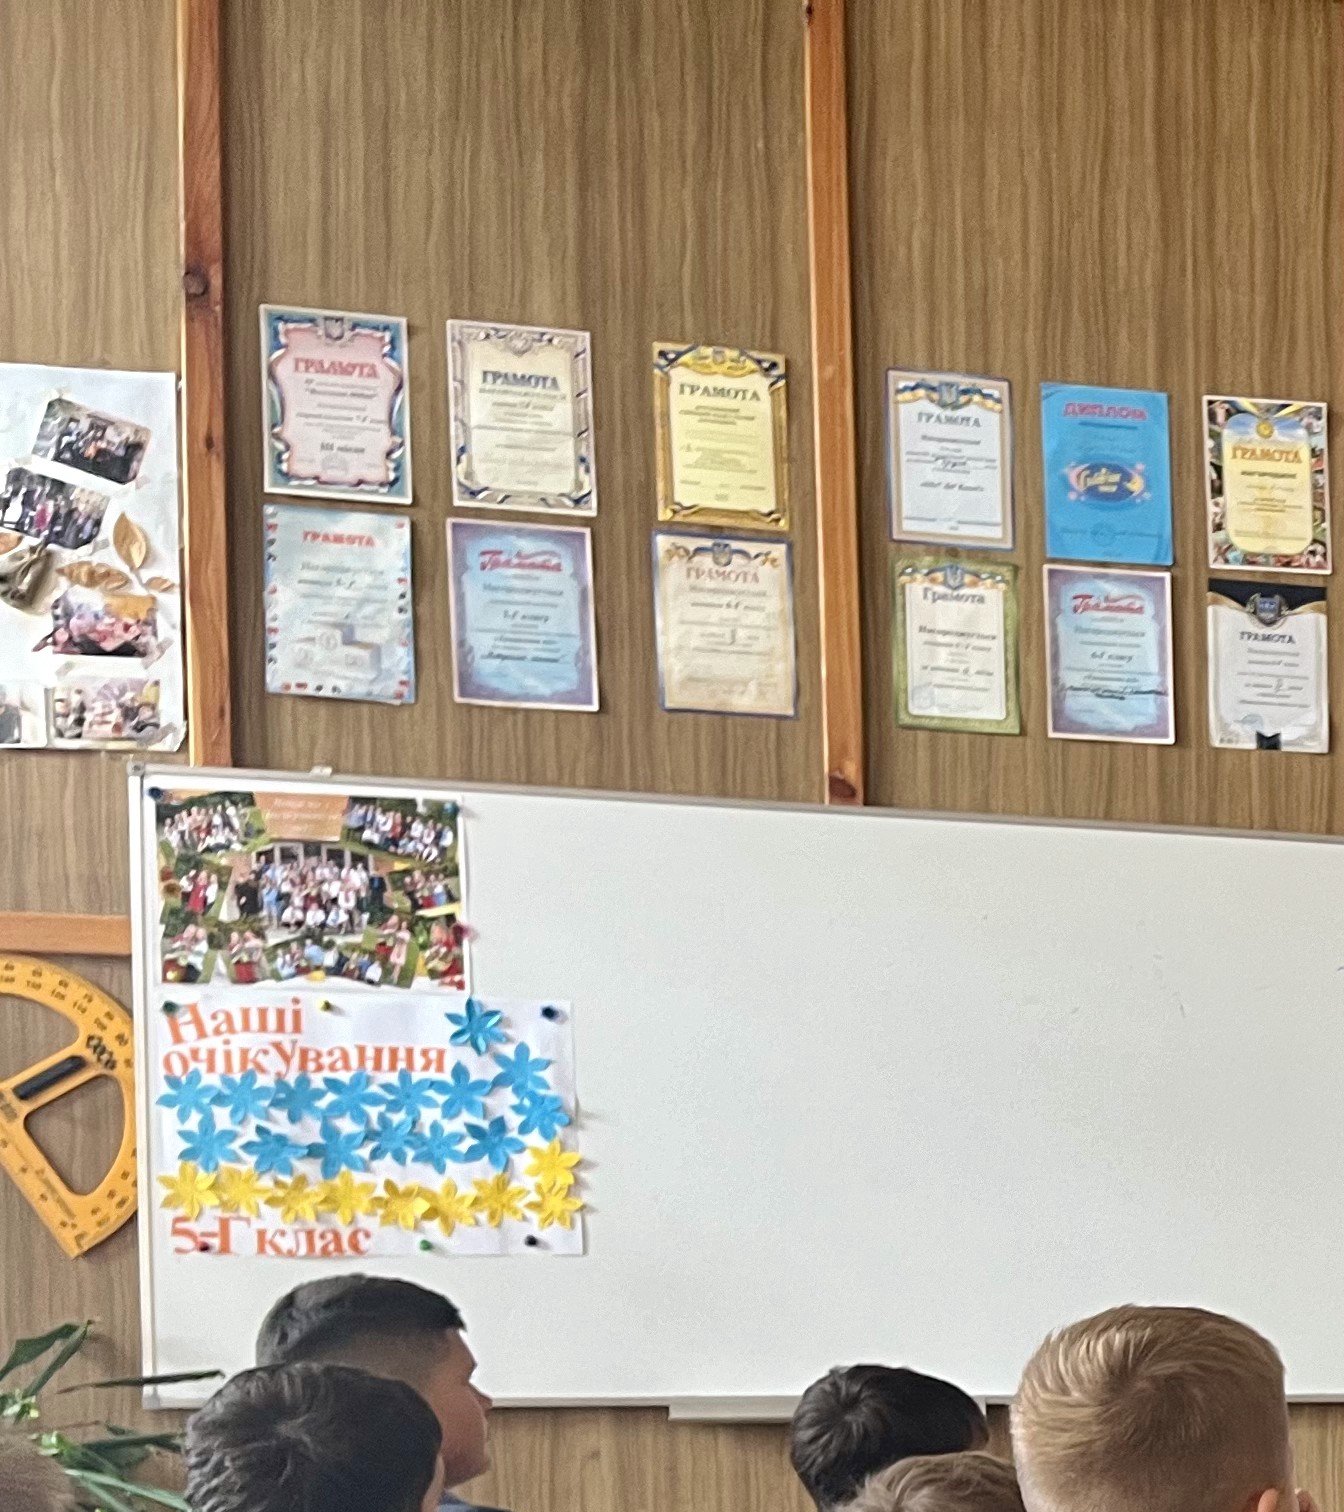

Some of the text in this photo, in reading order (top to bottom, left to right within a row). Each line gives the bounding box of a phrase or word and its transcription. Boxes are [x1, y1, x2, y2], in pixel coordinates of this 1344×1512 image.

[293, 357, 380, 379] ГРАМОТА
[481, 370, 560, 391] ГРАМОТА
[679, 383, 761, 401] ГРАМОТА
[917, 412, 982, 428] ГРАМОТА
[1231, 445, 1303, 464] ГРАМОТА
[303, 530, 376, 548] ГРАМОТА
[686, 566, 760, 584] ГРАМОТА
[923, 587, 985, 605] Грамота
[1239, 631, 1296, 645] ГРАМОТА
[165, 997, 304, 1046] Наші
[161, 1037, 448, 1080] очікування
[169, 1215, 373, 1257] 5-Г клас
